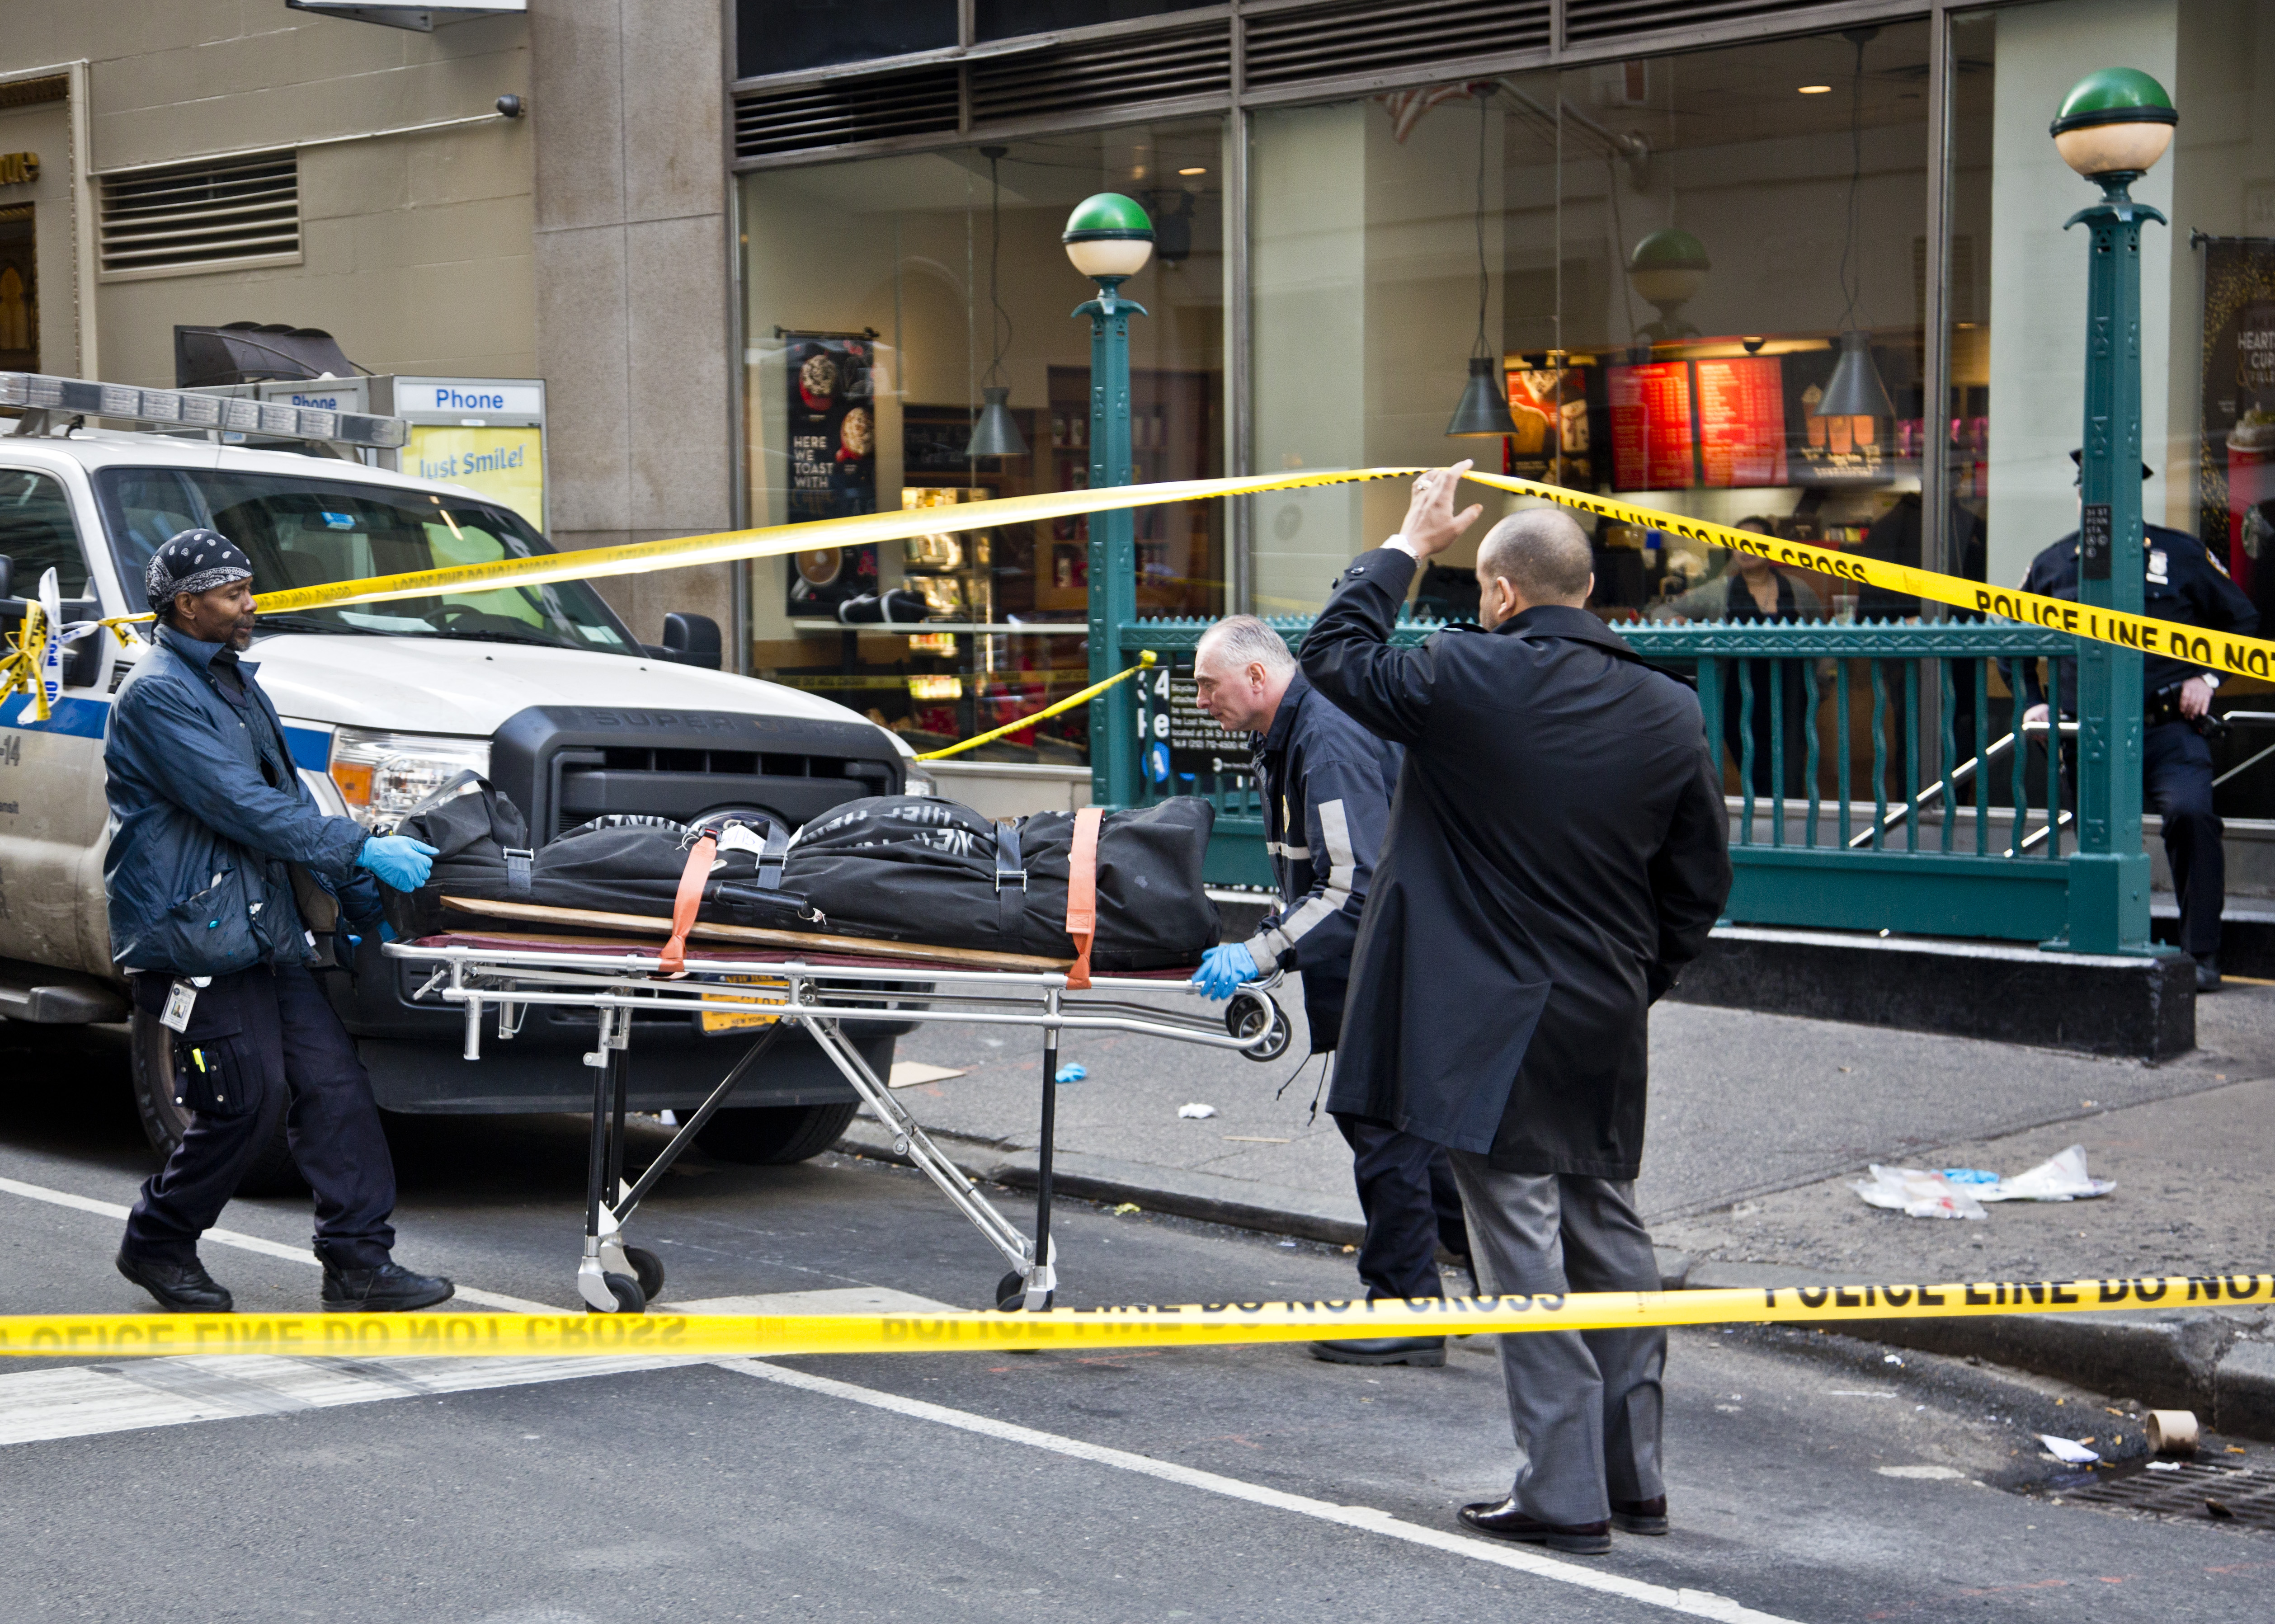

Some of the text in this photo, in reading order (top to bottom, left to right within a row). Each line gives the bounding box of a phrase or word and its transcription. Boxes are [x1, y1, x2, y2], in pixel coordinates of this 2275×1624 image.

[292, 395, 337, 410] Phone
[436, 389, 504, 408] Phone
[794, 436, 827, 447] HERE
[420, 445, 524, 479] Just Smile!
[794, 449, 814, 461] WE
[794, 462, 834, 474] TOAST
[795, 476, 828, 488] WITH
[1781, 548, 1870, 584] CROSS
[1975, 589, 2078, 631] POLICE
[2091, 615, 2158, 651] LINE
[2171, 632, 2212, 664] DO
[594, 711, 738, 730] SUPER
[1964, 1281, 2078, 1305] LINE
[2100, 1277, 2168, 1303] DO
[2186, 1275, 2275, 1300] NO
